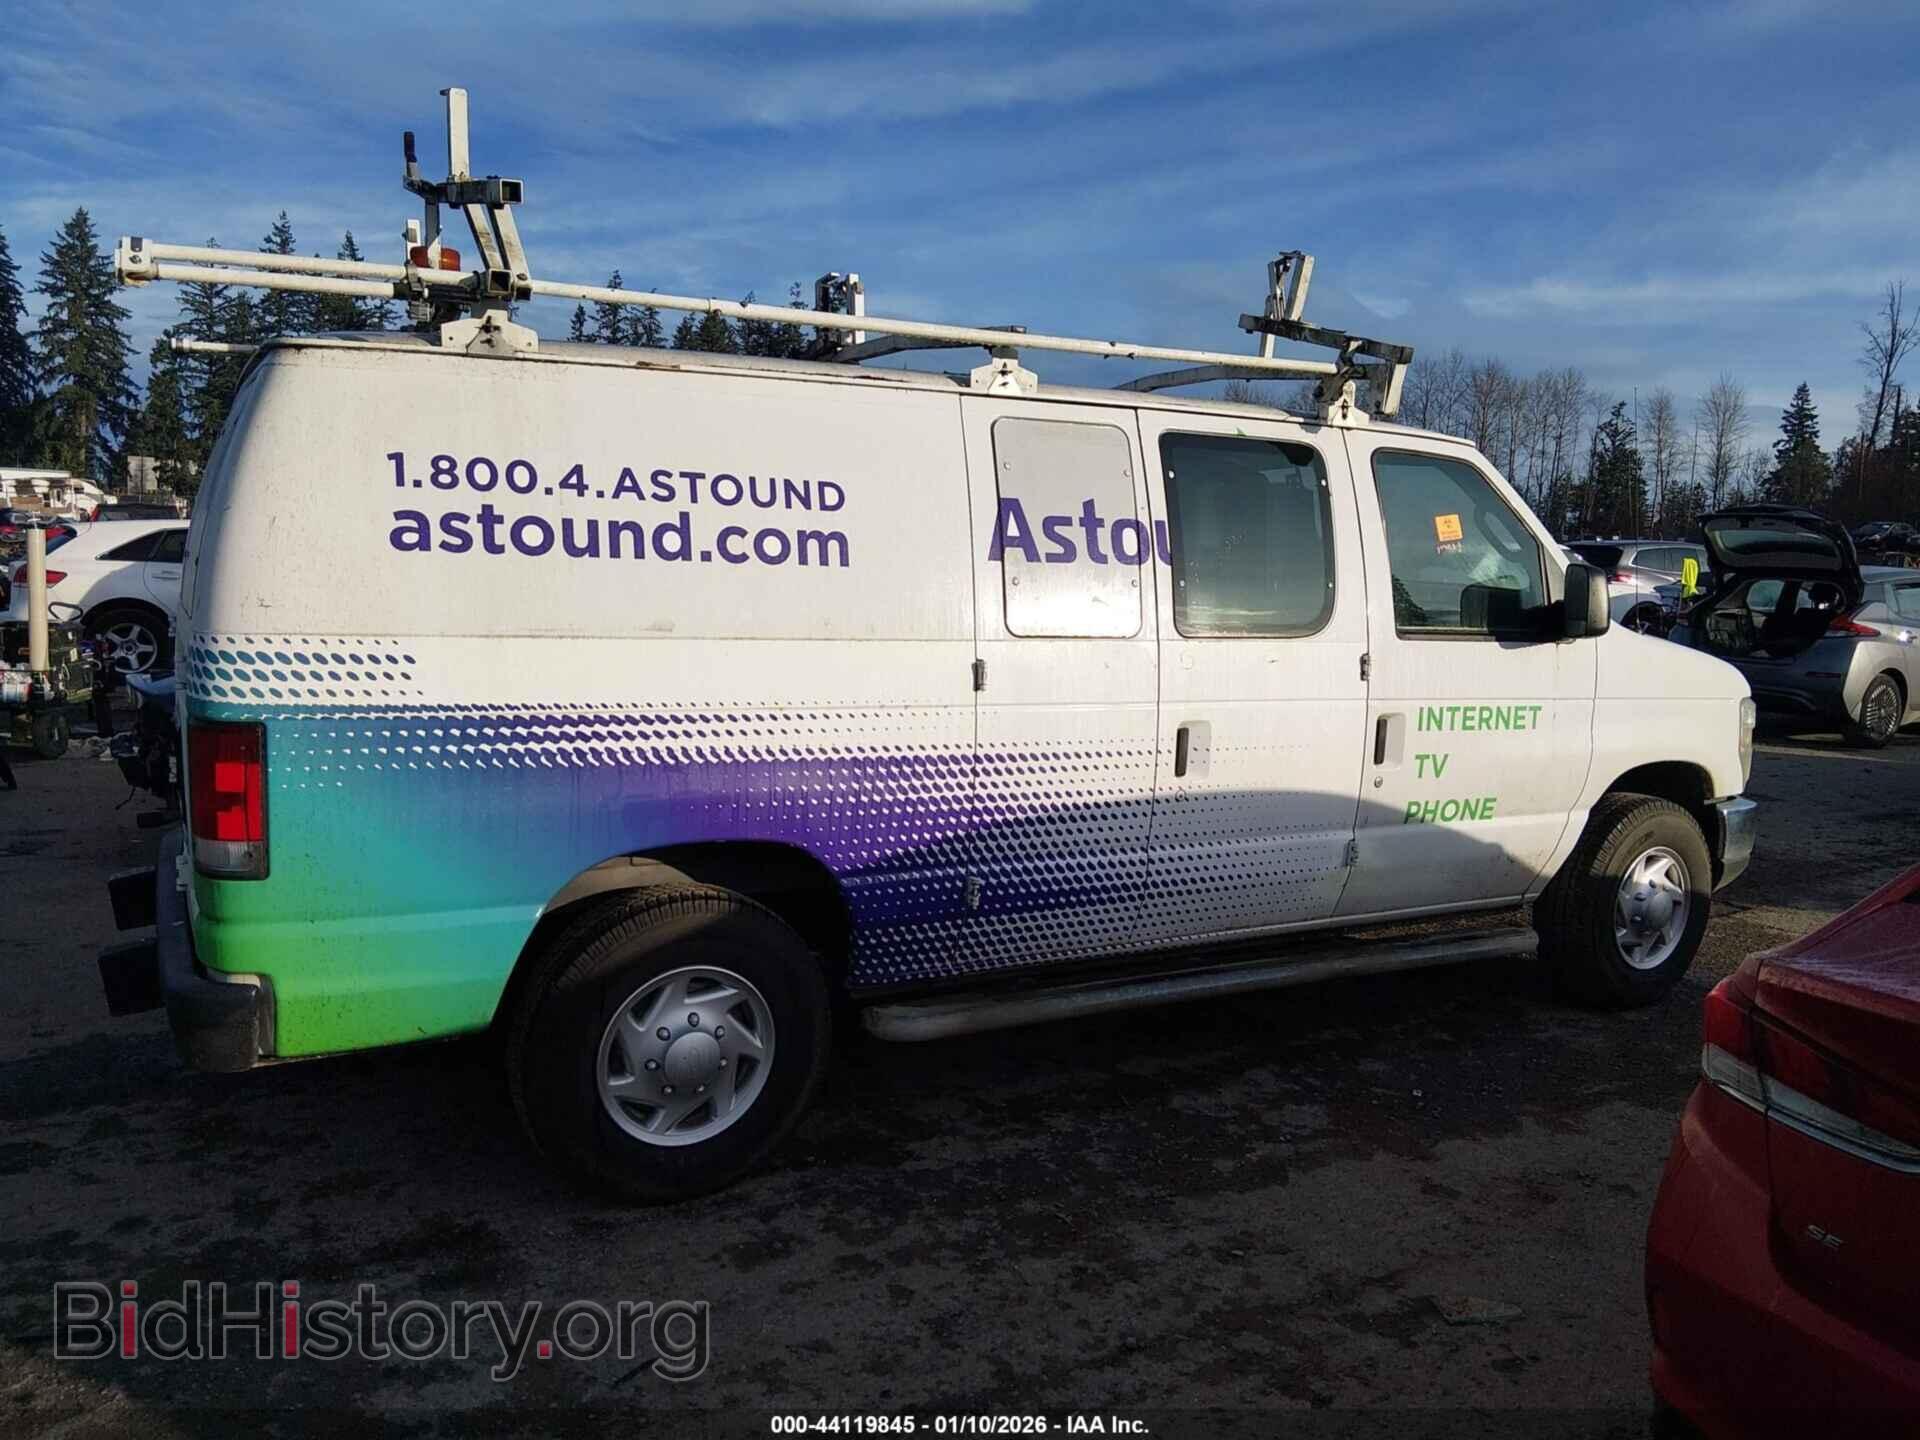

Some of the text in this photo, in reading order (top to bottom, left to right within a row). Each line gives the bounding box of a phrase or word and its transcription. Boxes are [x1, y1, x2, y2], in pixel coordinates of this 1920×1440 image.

[387, 451, 846, 512] 1.800.4.ASTOUND
[388, 503, 850, 568] astound.com
[1417, 706, 1542, 732] INTERNET
[1414, 753, 1449, 779] TV
[1404, 798, 1497, 824] PHONE
[1808, 1224, 1842, 1249] SE
